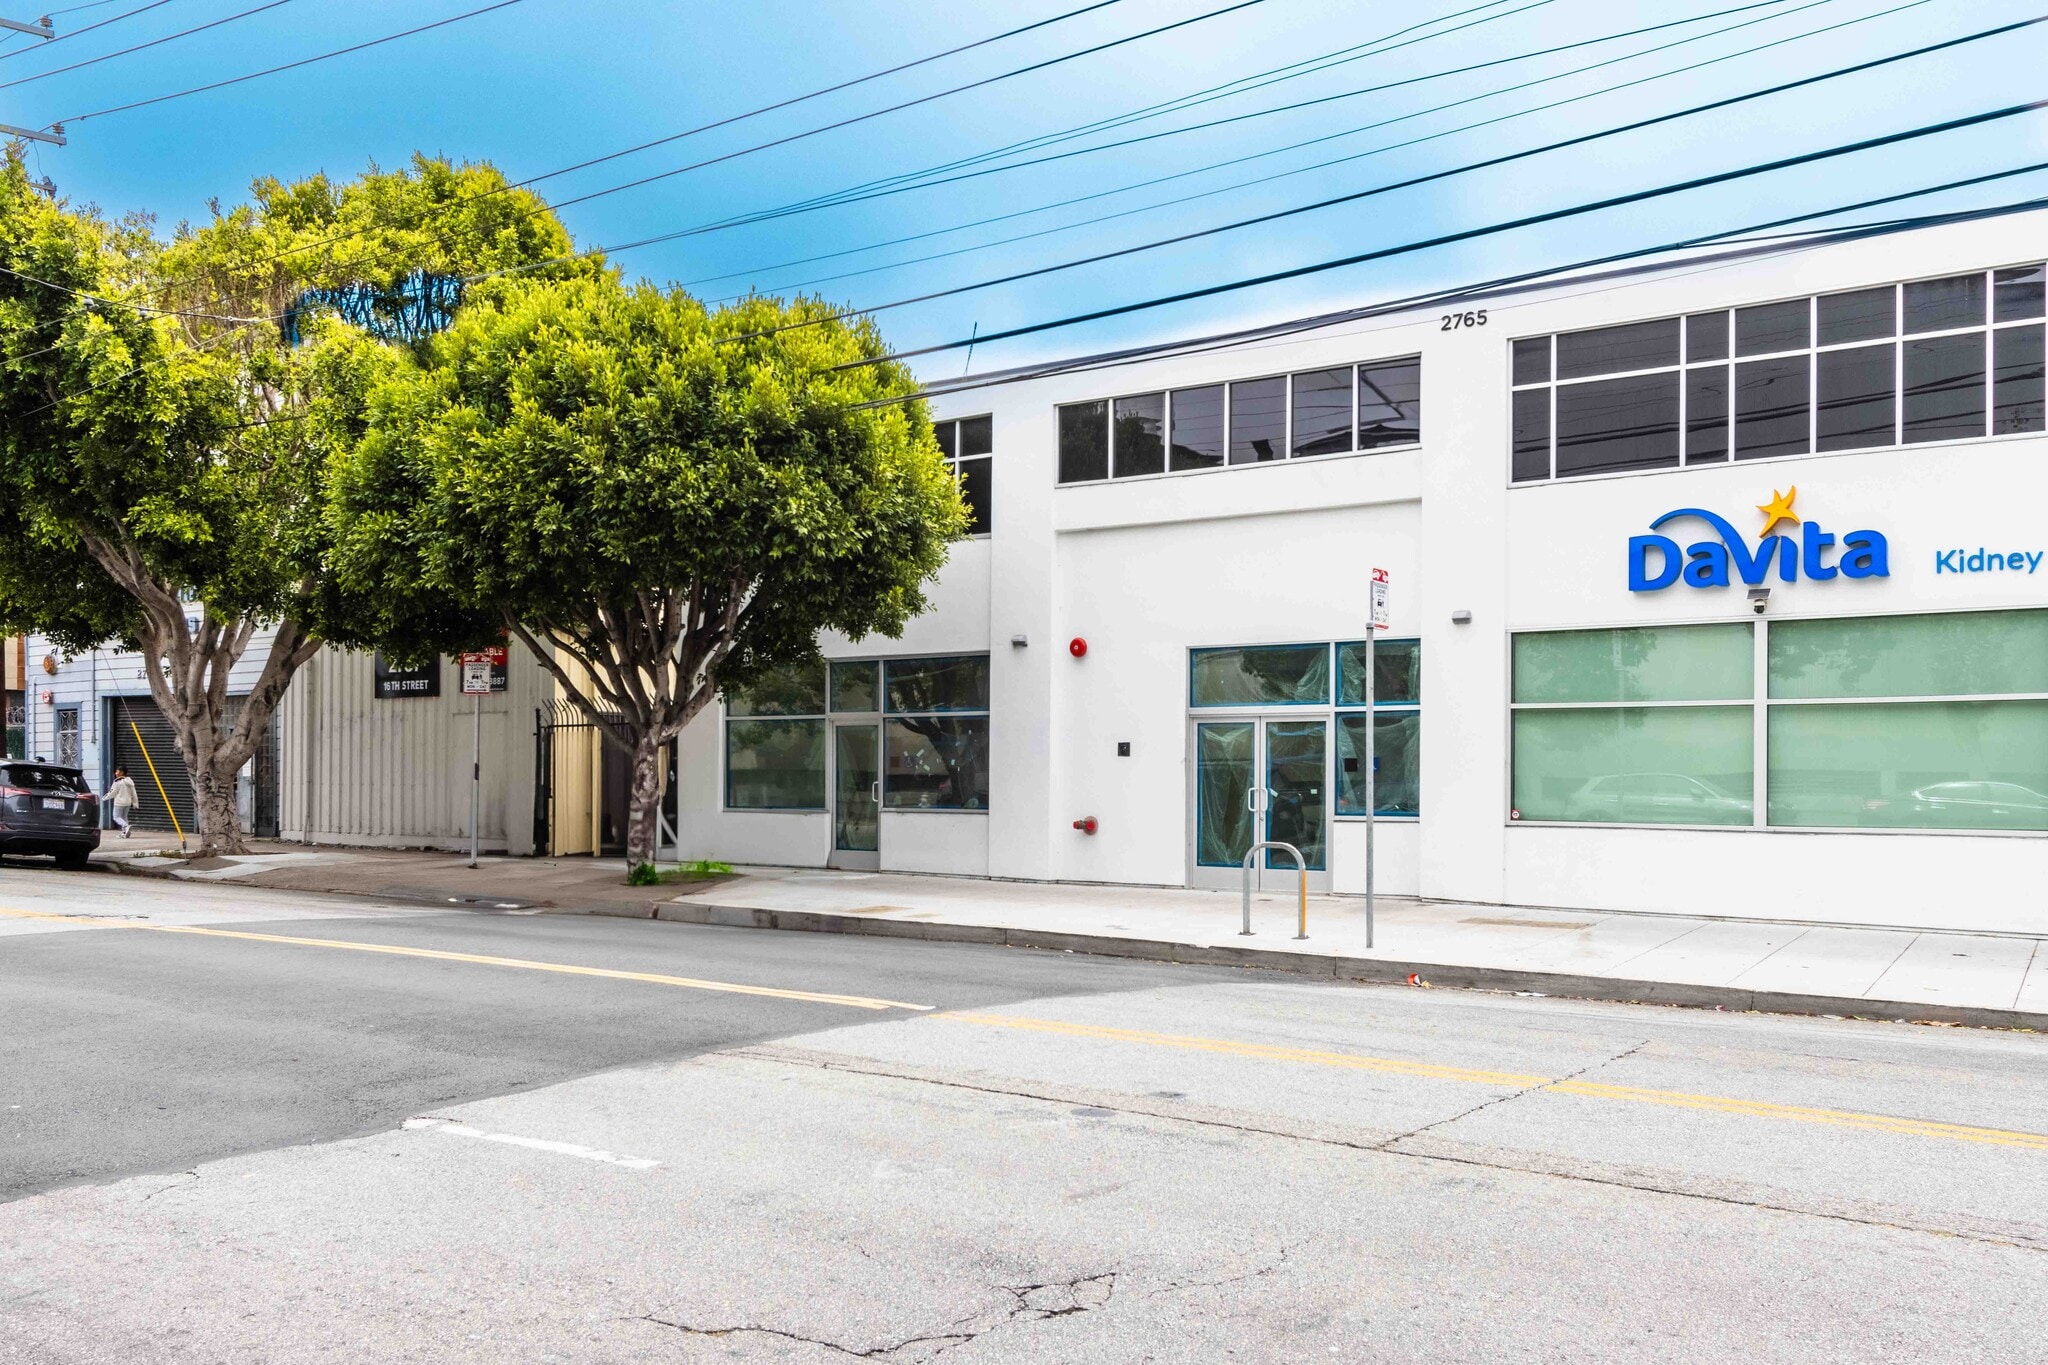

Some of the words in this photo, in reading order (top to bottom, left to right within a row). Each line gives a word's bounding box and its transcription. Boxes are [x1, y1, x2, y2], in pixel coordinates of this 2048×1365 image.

[1441, 309, 1488, 331] 2765
[1628, 508, 1891, 592] DaVita
[1935, 547, 2044, 575] Kidney
[383, 681, 400, 691] 16TH
[402, 680, 429, 690] STREET
